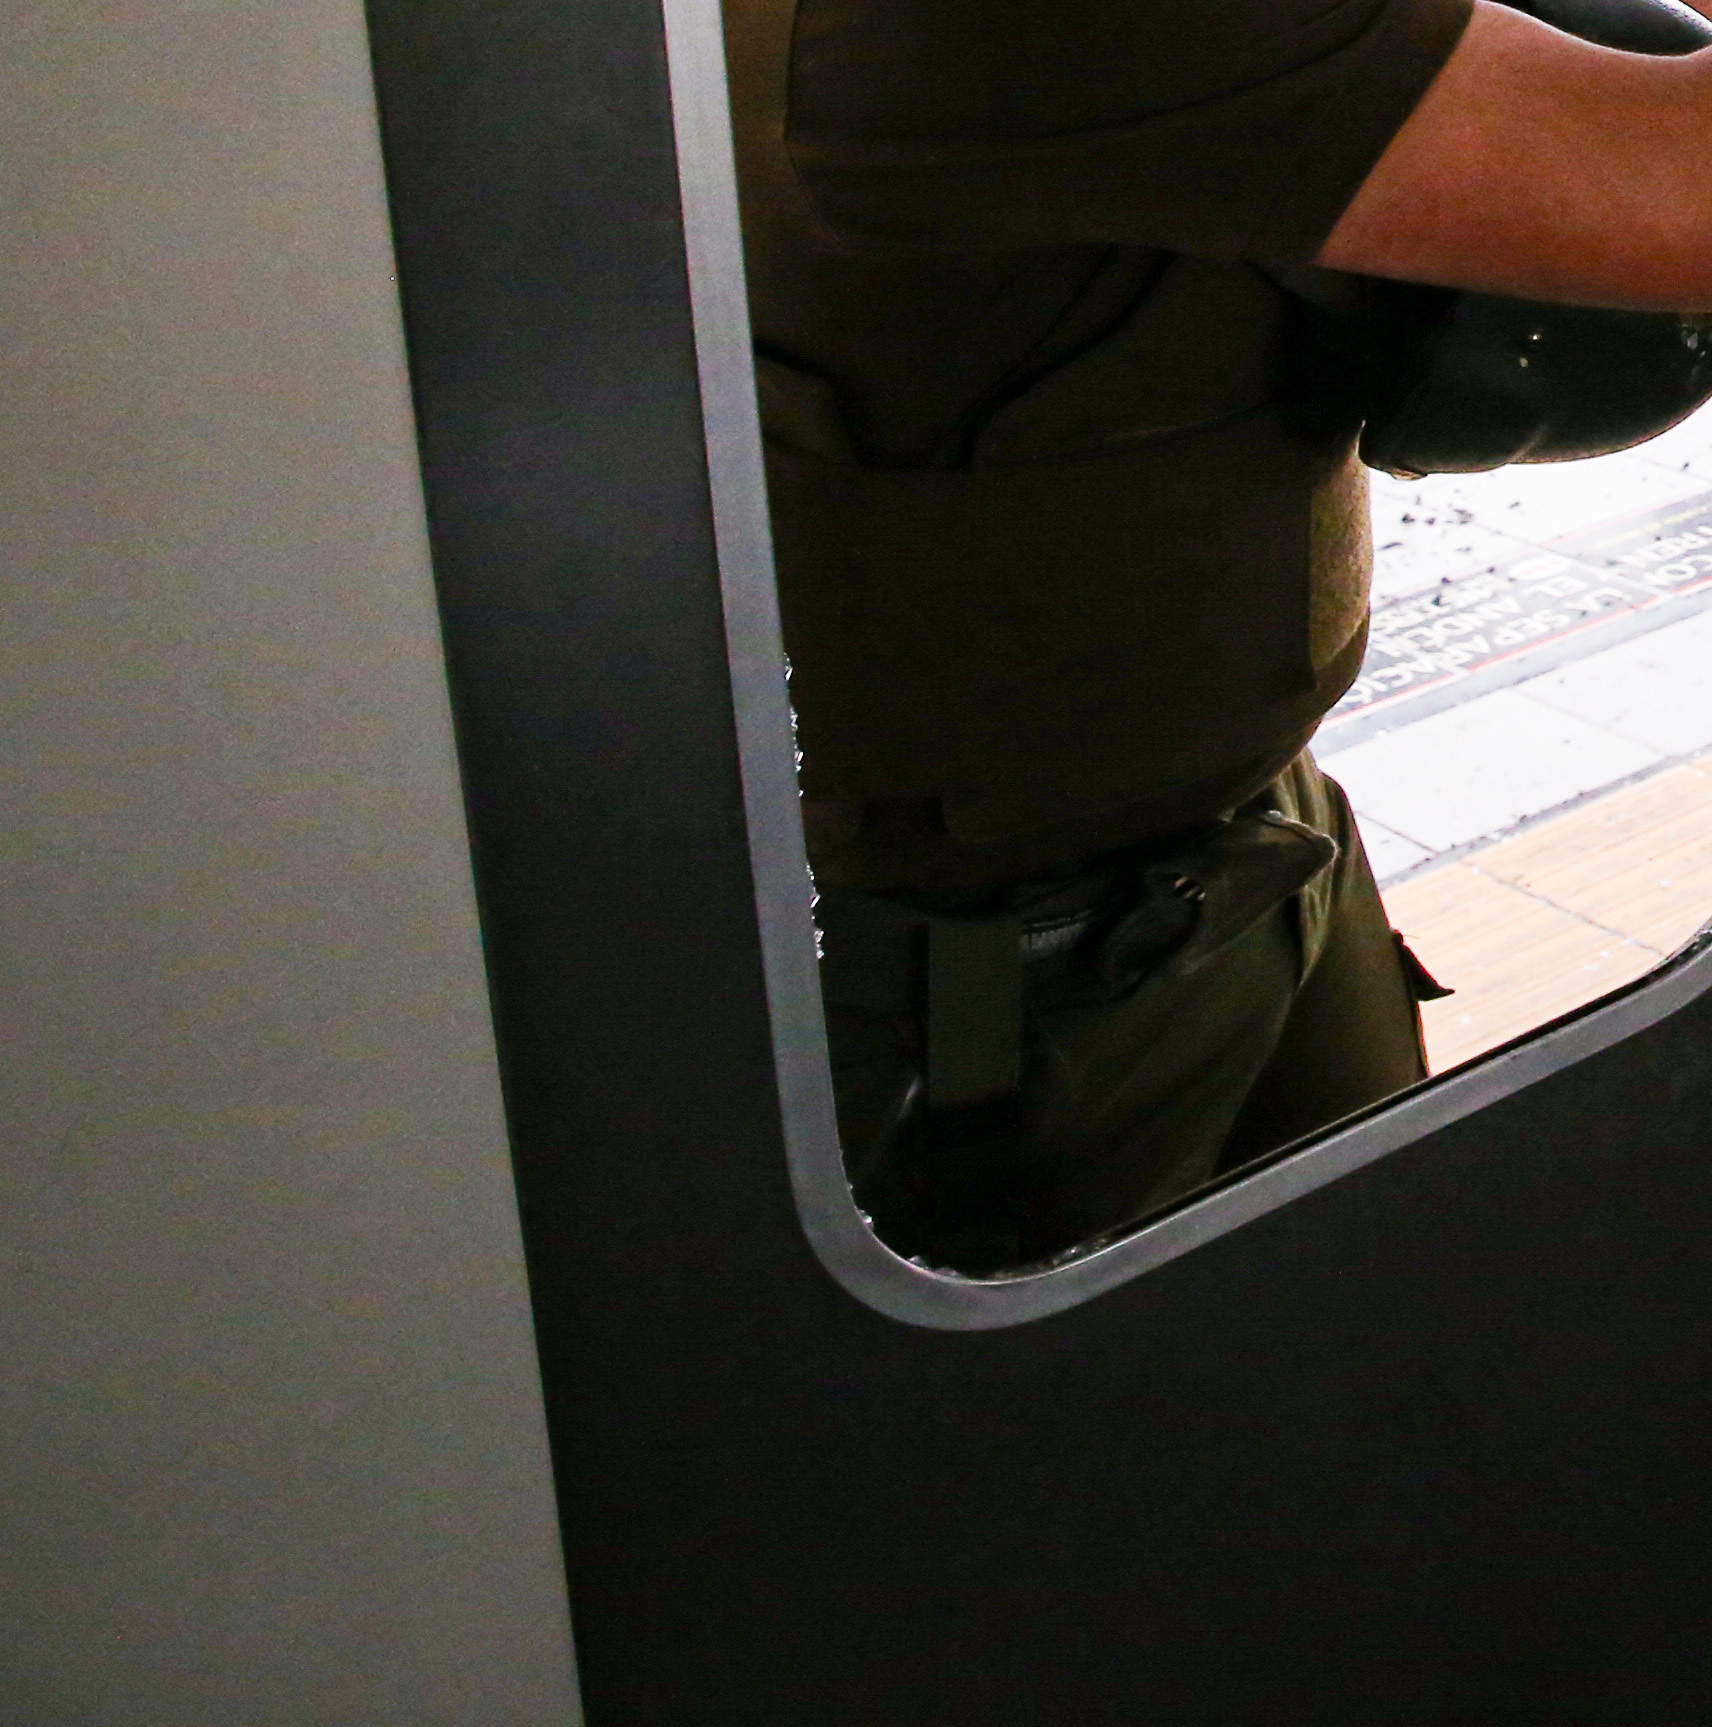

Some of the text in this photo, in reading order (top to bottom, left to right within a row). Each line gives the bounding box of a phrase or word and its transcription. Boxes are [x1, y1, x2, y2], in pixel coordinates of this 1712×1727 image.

[1522, 575, 1589, 600] EL
[1564, 586, 1633, 615] LA
[1330, 607, 1573, 706] SEPARACIÓ
